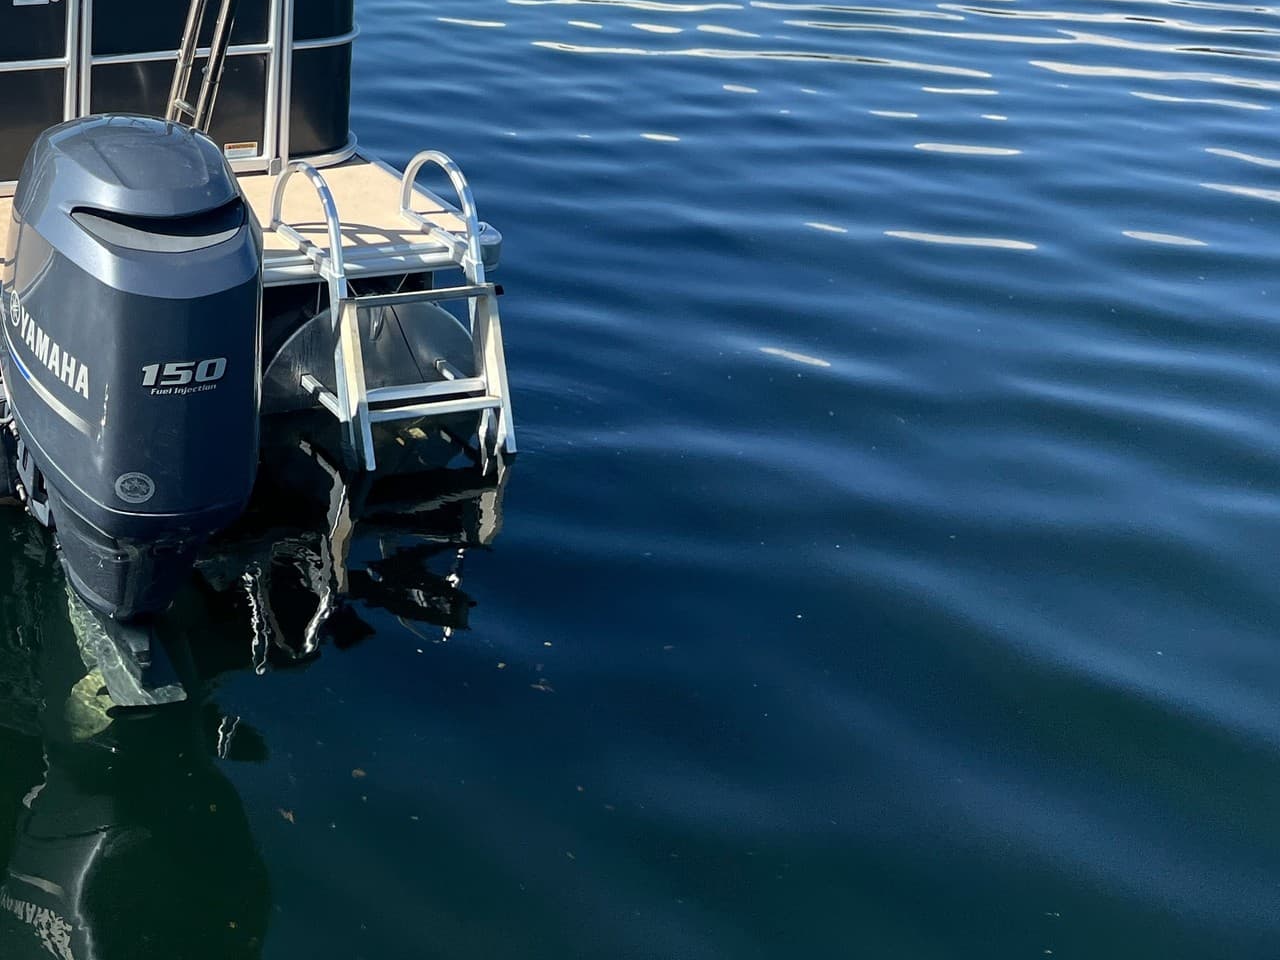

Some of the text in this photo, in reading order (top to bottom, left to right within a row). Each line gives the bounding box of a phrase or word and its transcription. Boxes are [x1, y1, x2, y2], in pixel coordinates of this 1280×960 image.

[21, 305, 89, 400] YAMAHA
[141, 357, 227, 386] 150
[150, 383, 217, 396] Fuel Injection
